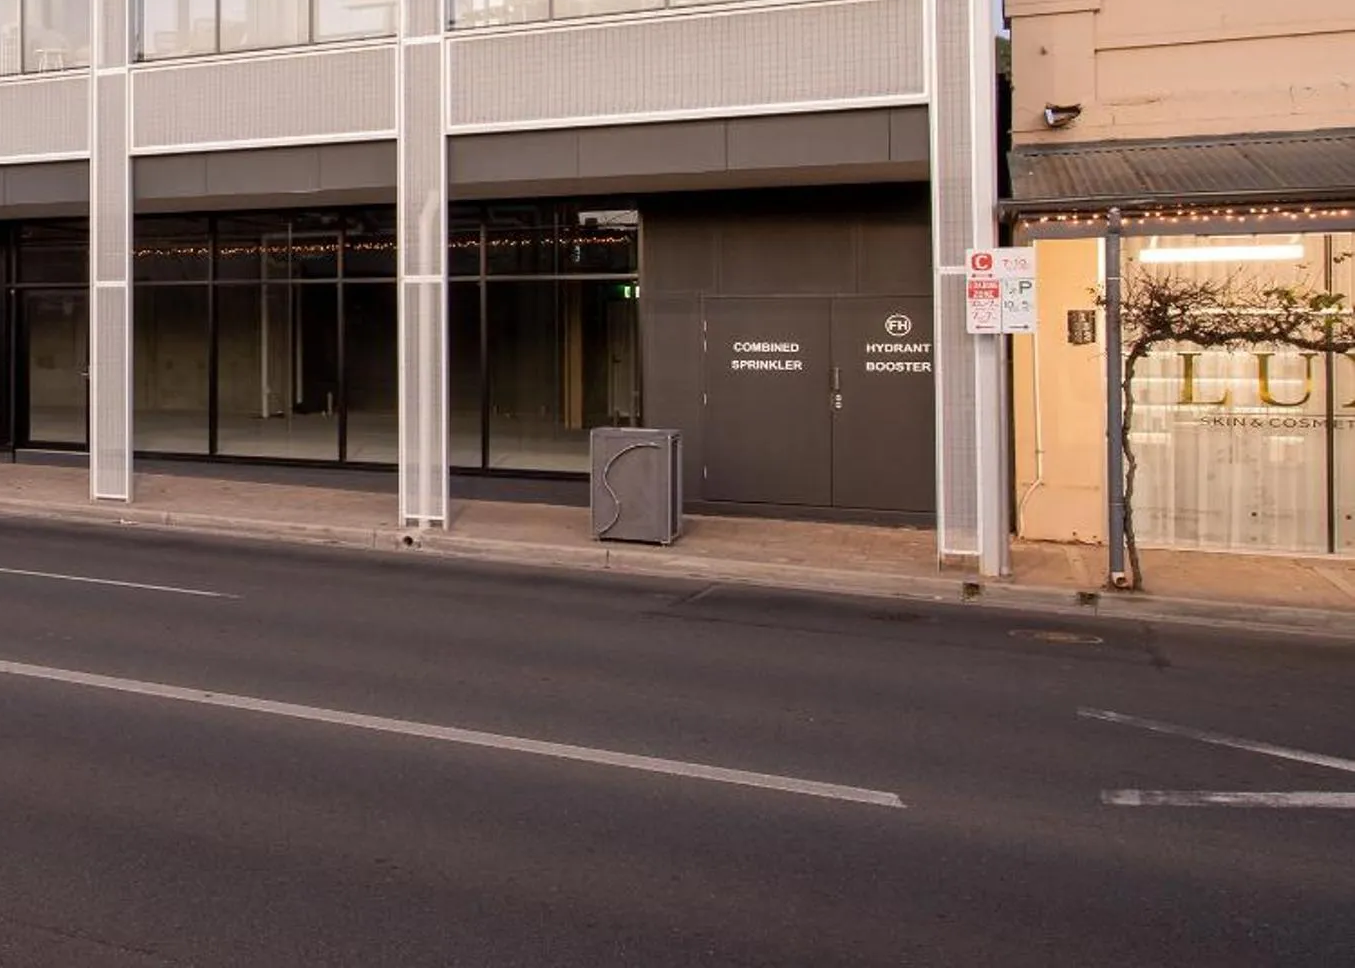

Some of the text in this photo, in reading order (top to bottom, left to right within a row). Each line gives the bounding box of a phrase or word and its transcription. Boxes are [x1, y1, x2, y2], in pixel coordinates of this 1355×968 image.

[733, 342, 799, 352] COMBINED
[866, 343, 932, 353] HYDRANT
[731, 359, 803, 370] SPRINKLER
[866, 361, 932, 372] BOOSTER
[1176, 352, 1355, 407] LU
[1200, 416, 1245, 427] SKIN
[1250, 417, 1263, 428] &
